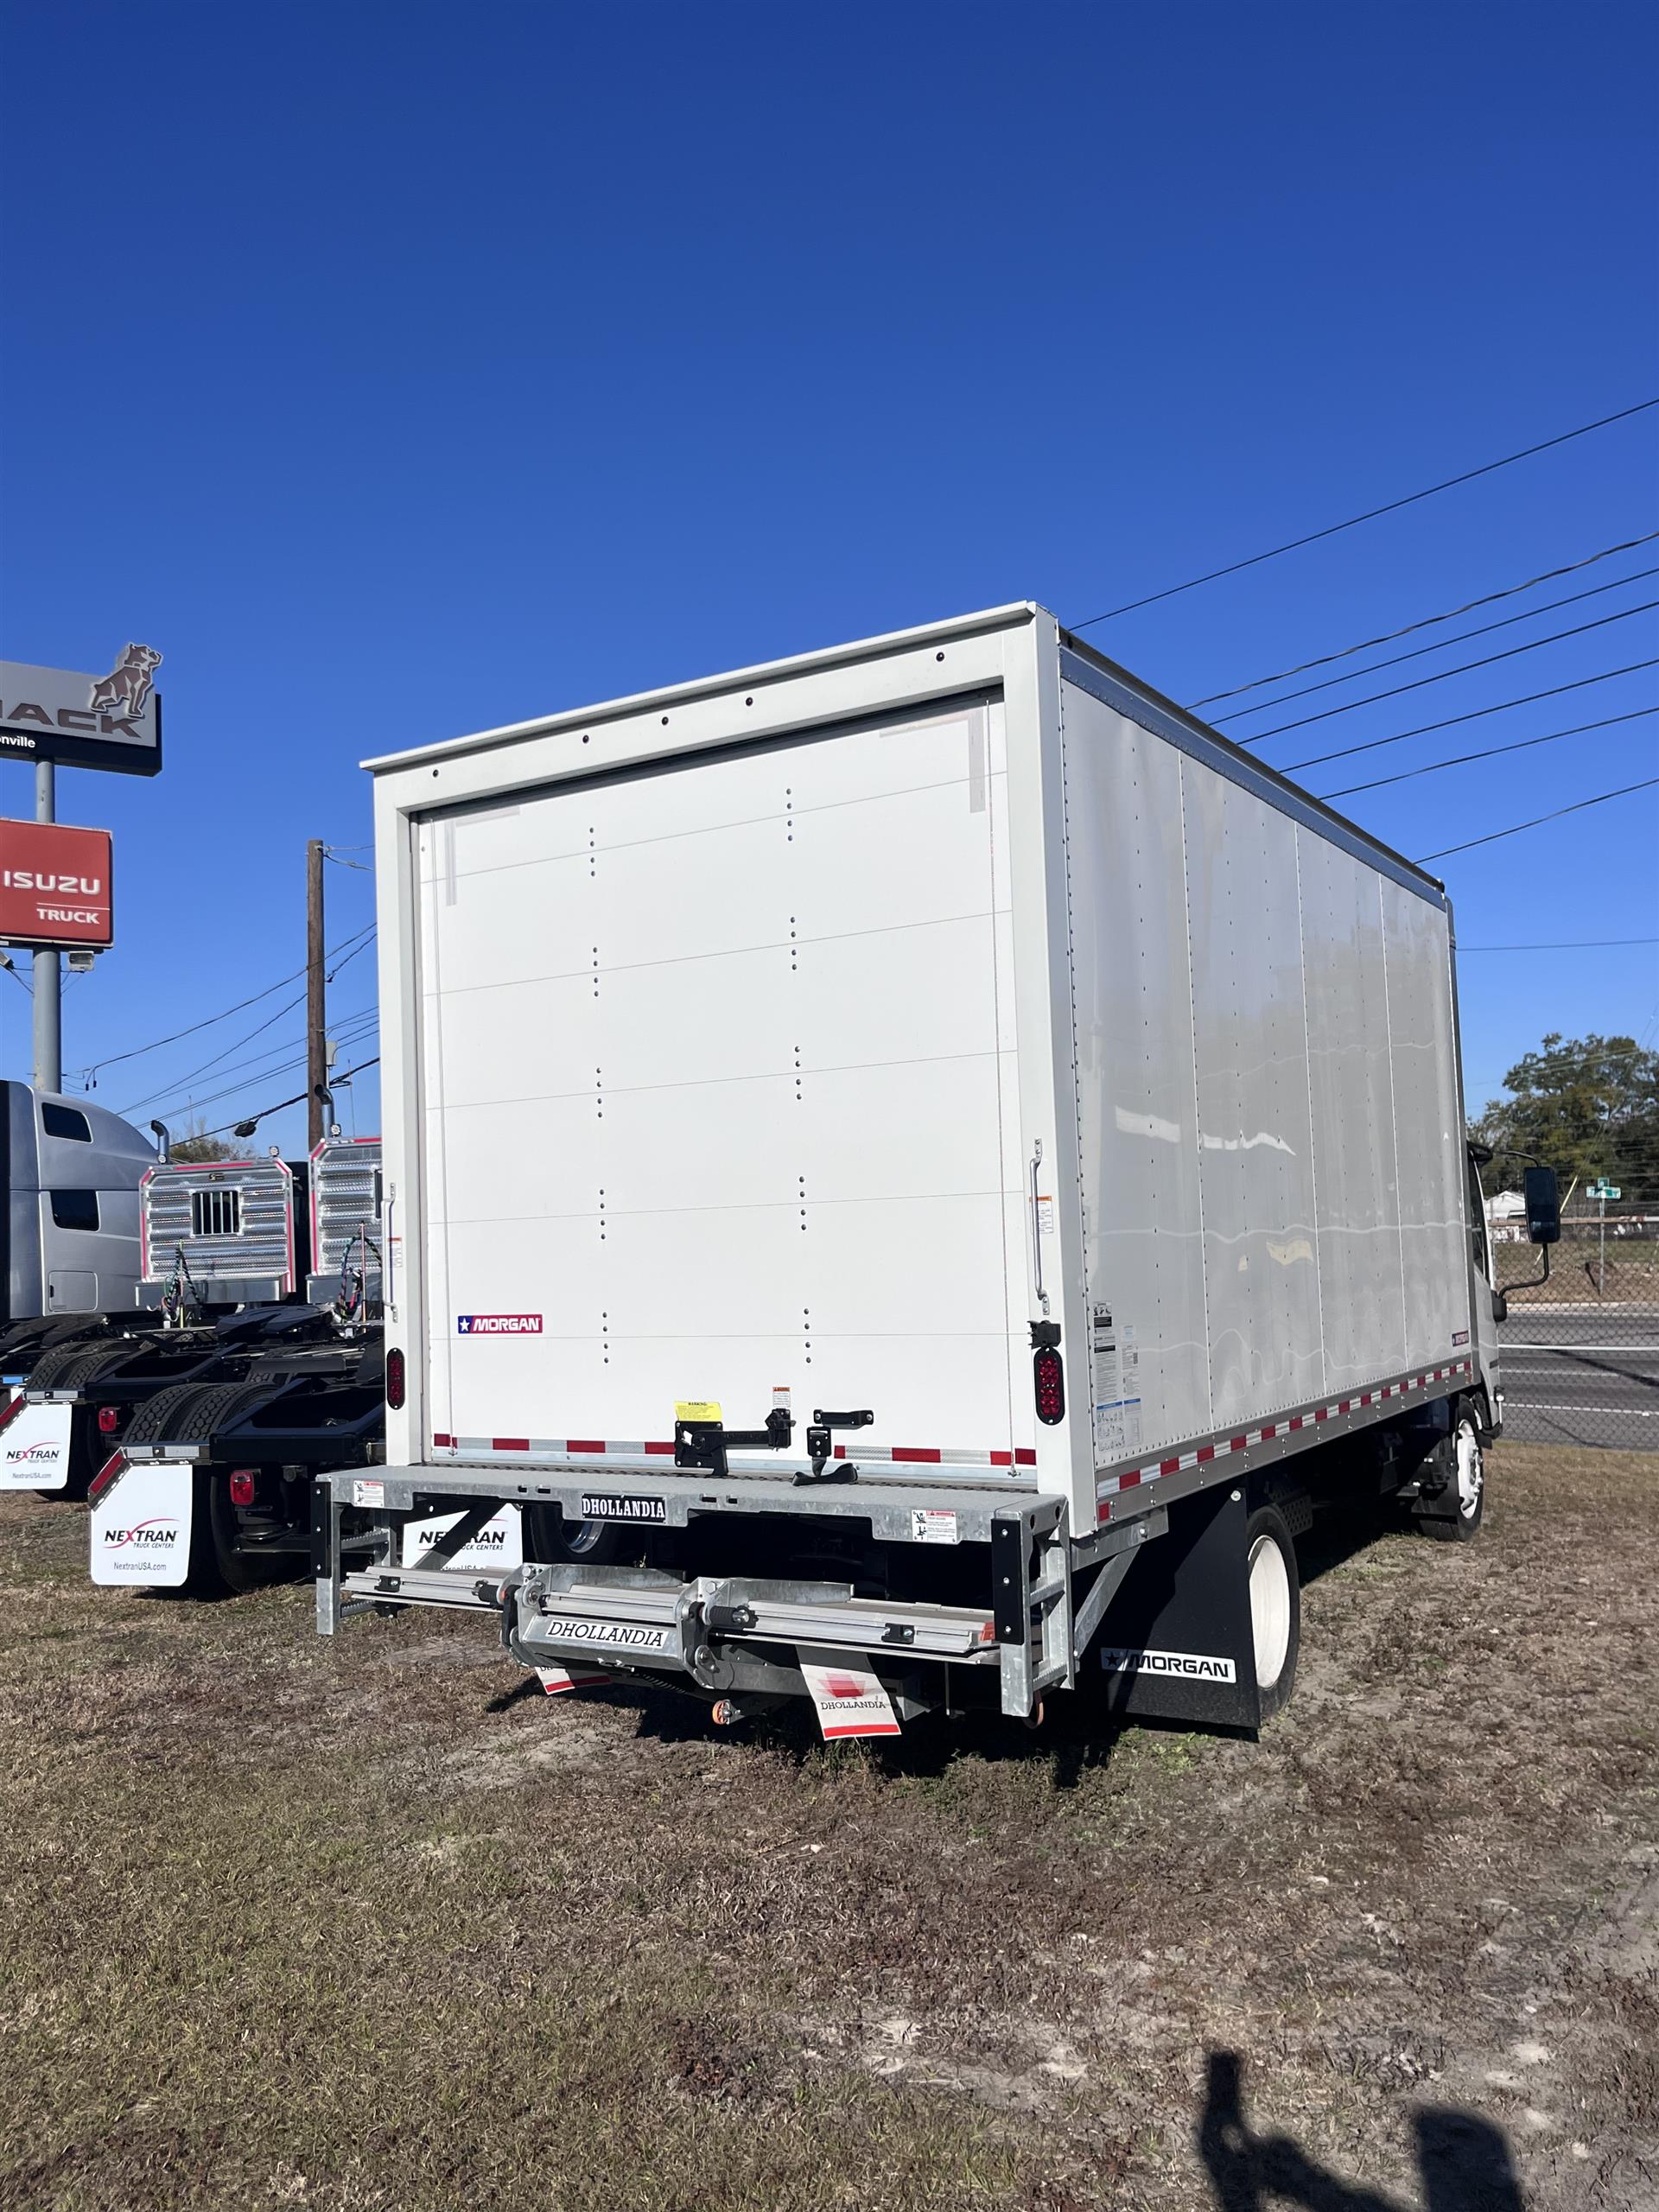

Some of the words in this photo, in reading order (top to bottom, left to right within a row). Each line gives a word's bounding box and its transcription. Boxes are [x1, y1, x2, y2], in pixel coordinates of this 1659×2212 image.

[0, 700, 141, 738] ACK
[3, 870, 100, 894] ISUZU
[36, 908, 100, 925] TRUCK
[473, 1318, 540, 1332] MORGAN
[6, 1450, 60, 1459] NEXTRAN
[582, 1497, 665, 1518] DHOLLANDIA
[104, 1530, 177, 1542] NEXTRAN
[113, 1561, 167, 1571] NextranUSA.com
[548, 1622, 664, 1647] DHOLLANDIA
[1128, 1654, 1229, 1678] MORGAN
[820, 1700, 887, 1710] DHOLLANDIA
